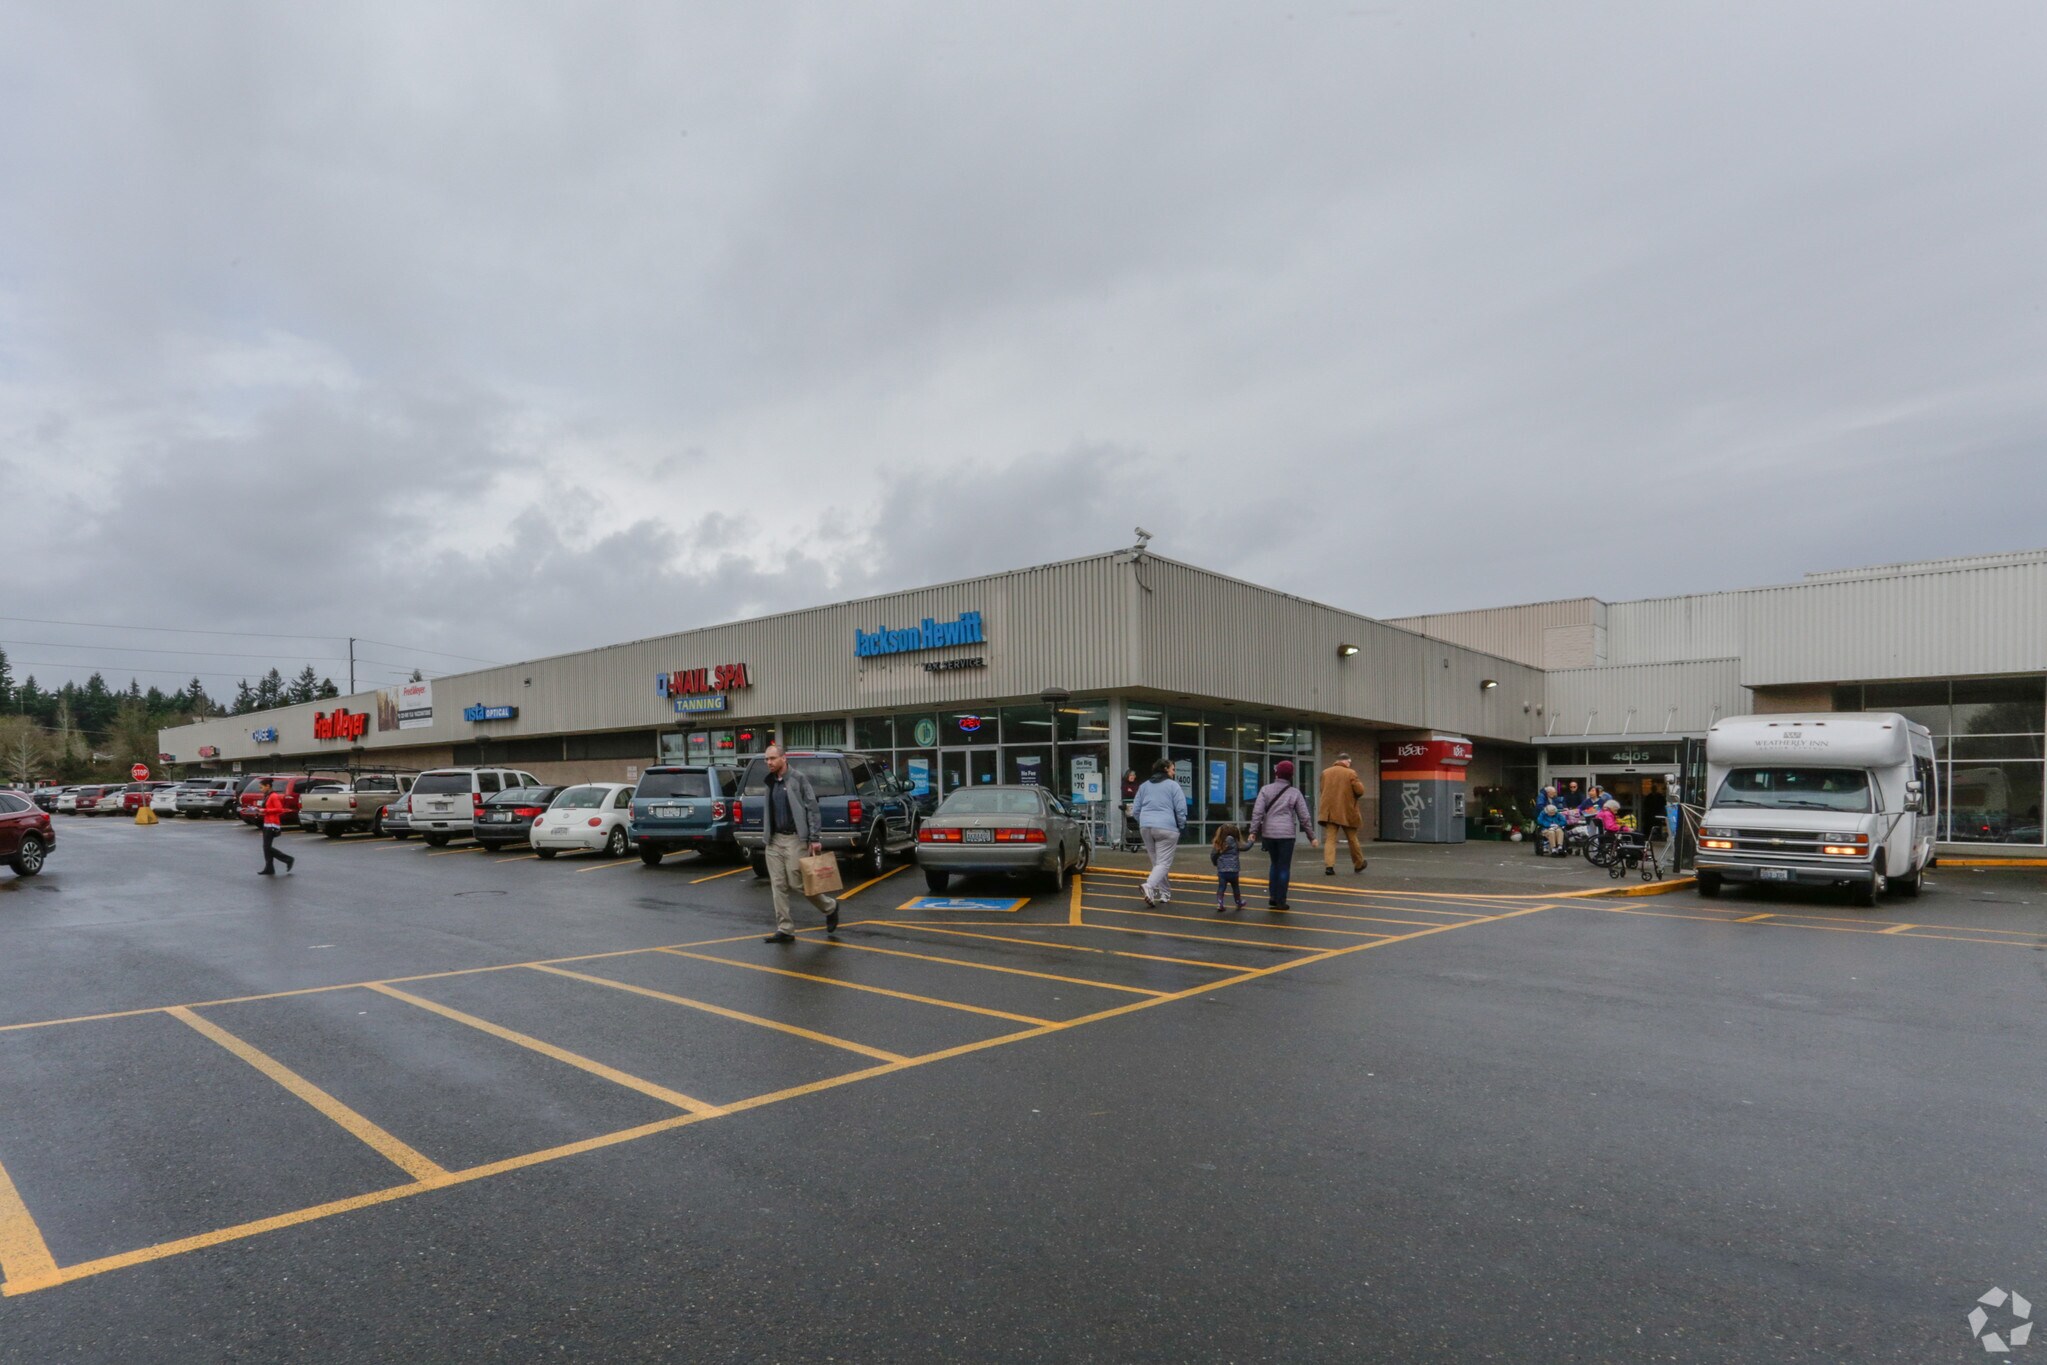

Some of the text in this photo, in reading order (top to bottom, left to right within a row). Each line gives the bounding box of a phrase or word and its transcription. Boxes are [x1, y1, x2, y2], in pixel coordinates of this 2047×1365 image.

[854, 611, 983, 657] Jackson Hewitt
[943, 658, 984, 670] SERVICE
[714, 663, 750, 691] SPA
[676, 697, 722, 711] TANNING
[485, 708, 510, 718] OPTICAL
[314, 708, 367, 742] Fred Meyer
[959, 717, 981, 728] OPEN
[251, 729, 270, 742] CHASE
[1754, 739, 1806, 747] WEATHERLY
